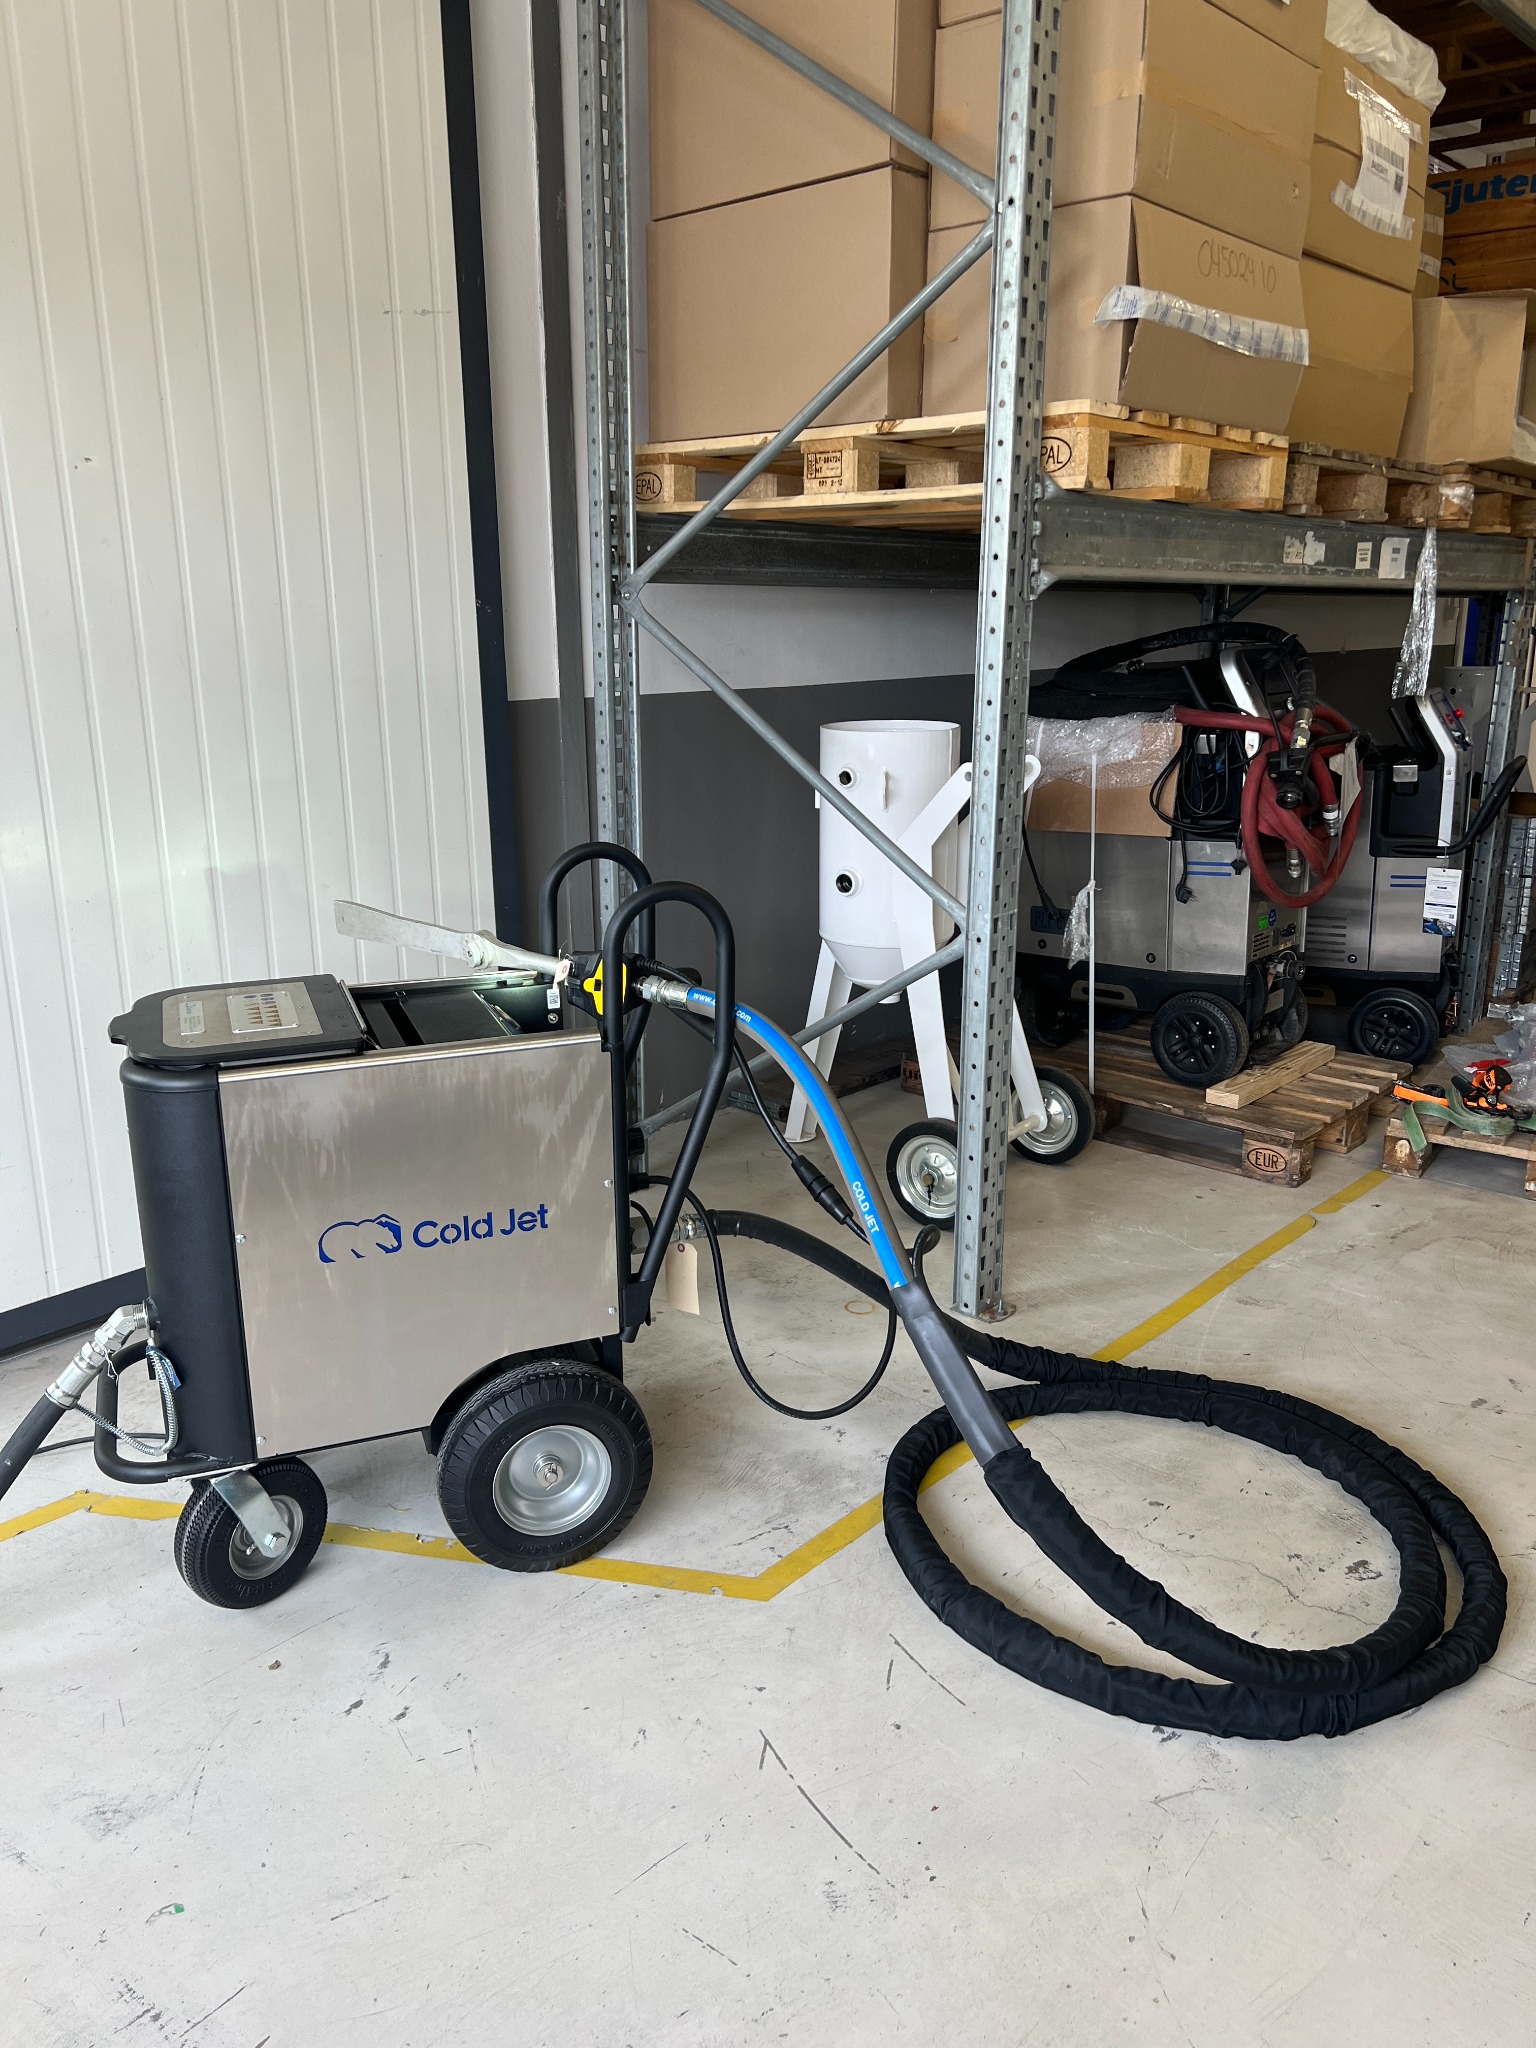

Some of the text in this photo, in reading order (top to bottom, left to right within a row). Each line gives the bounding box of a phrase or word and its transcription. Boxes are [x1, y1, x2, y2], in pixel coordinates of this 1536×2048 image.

[1041, 445, 1063, 464] PAL
[636, 479, 657, 495] EPAL
[1255, 1151, 1279, 1170] EUR
[852, 1181, 880, 1233] COLD JET
[412, 1203, 549, 1249] Cold Jet
